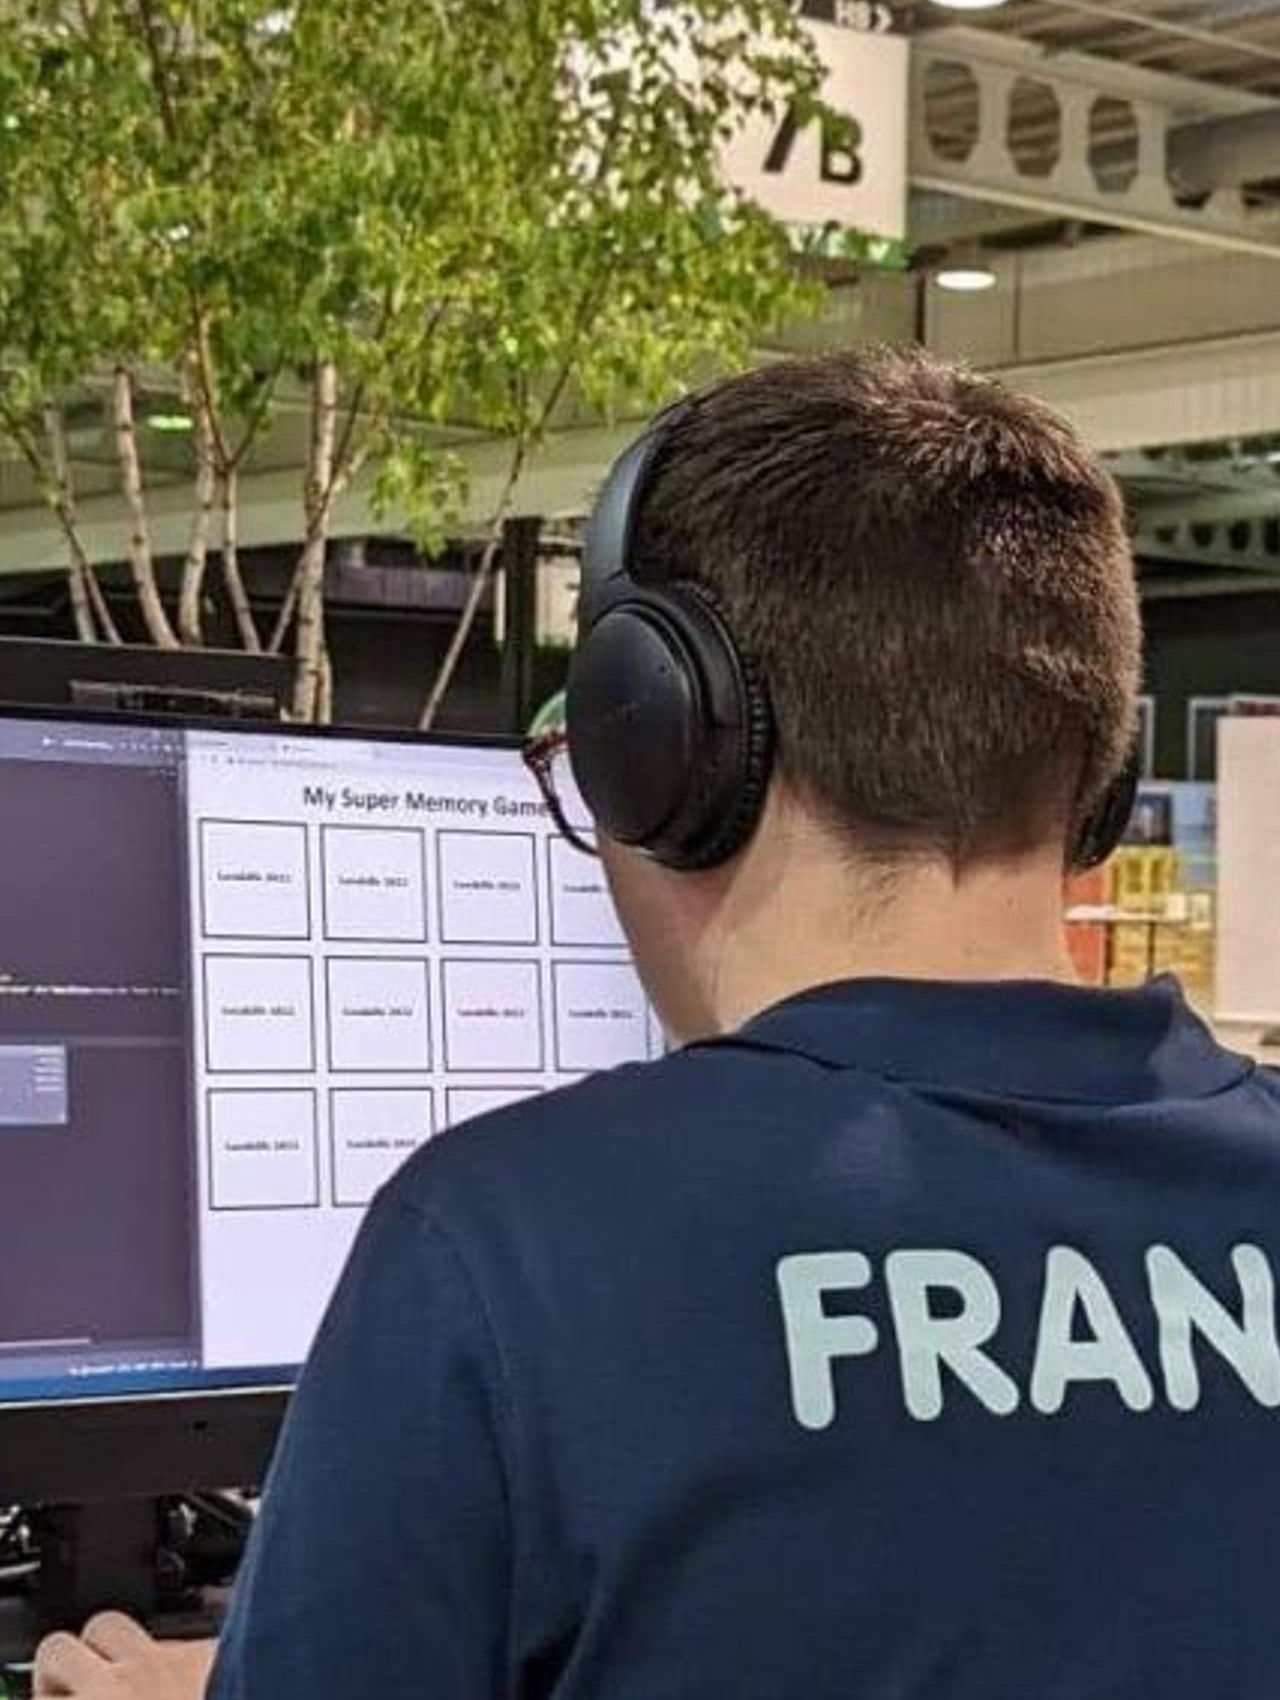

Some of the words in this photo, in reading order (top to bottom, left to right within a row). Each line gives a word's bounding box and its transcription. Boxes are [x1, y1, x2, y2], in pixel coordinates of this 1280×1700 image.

[302, 786, 336, 812] My
[340, 788, 400, 812] Super
[405, 791, 488, 818] Memory
